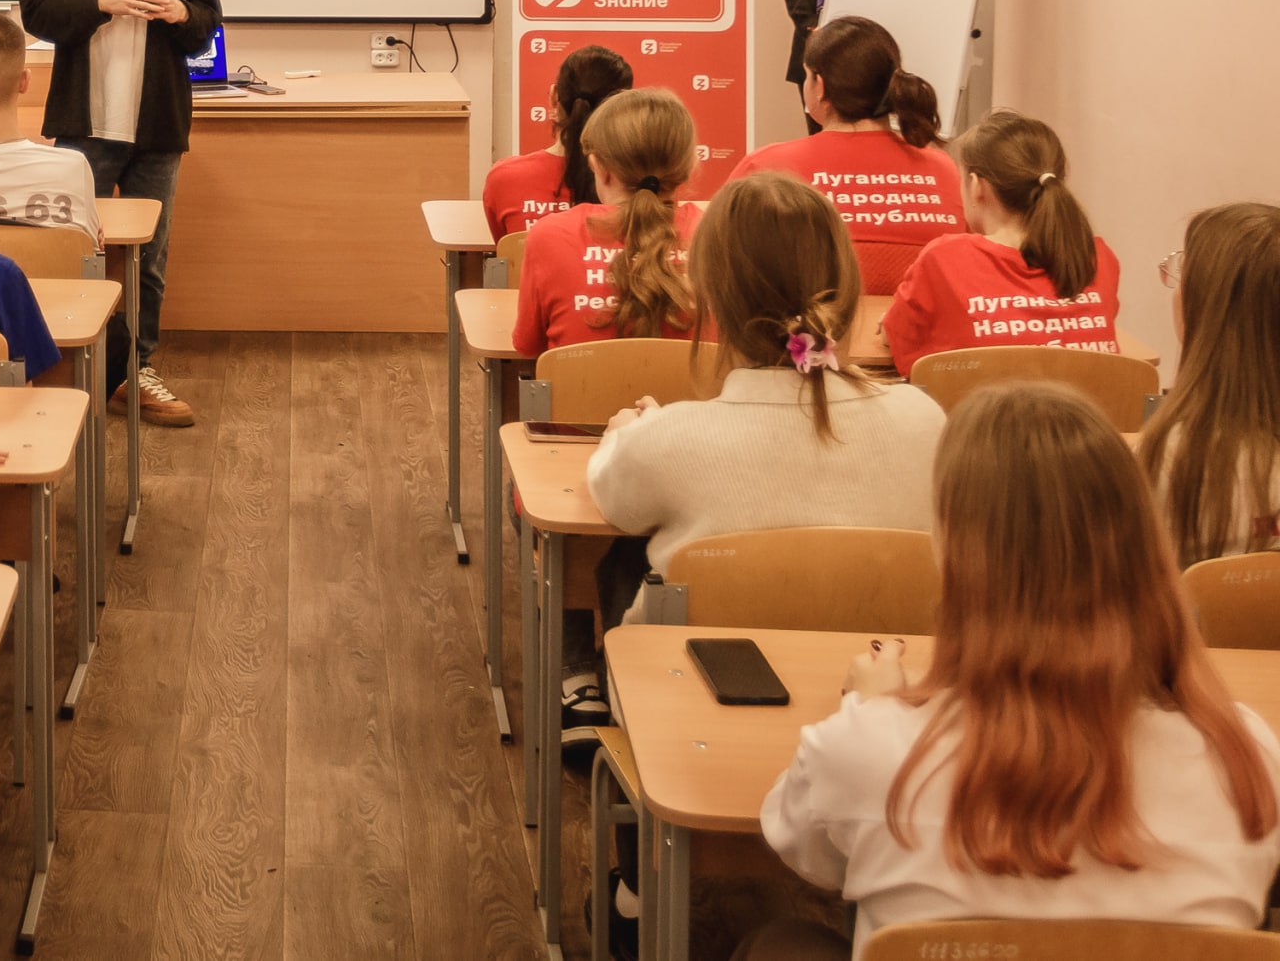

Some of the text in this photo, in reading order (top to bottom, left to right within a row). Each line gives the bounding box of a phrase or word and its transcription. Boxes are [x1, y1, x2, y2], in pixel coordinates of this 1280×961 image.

[811, 172, 937, 187] Луганская
[839, 209, 958, 226] спублика
[973, 315, 1108, 337] Народная
